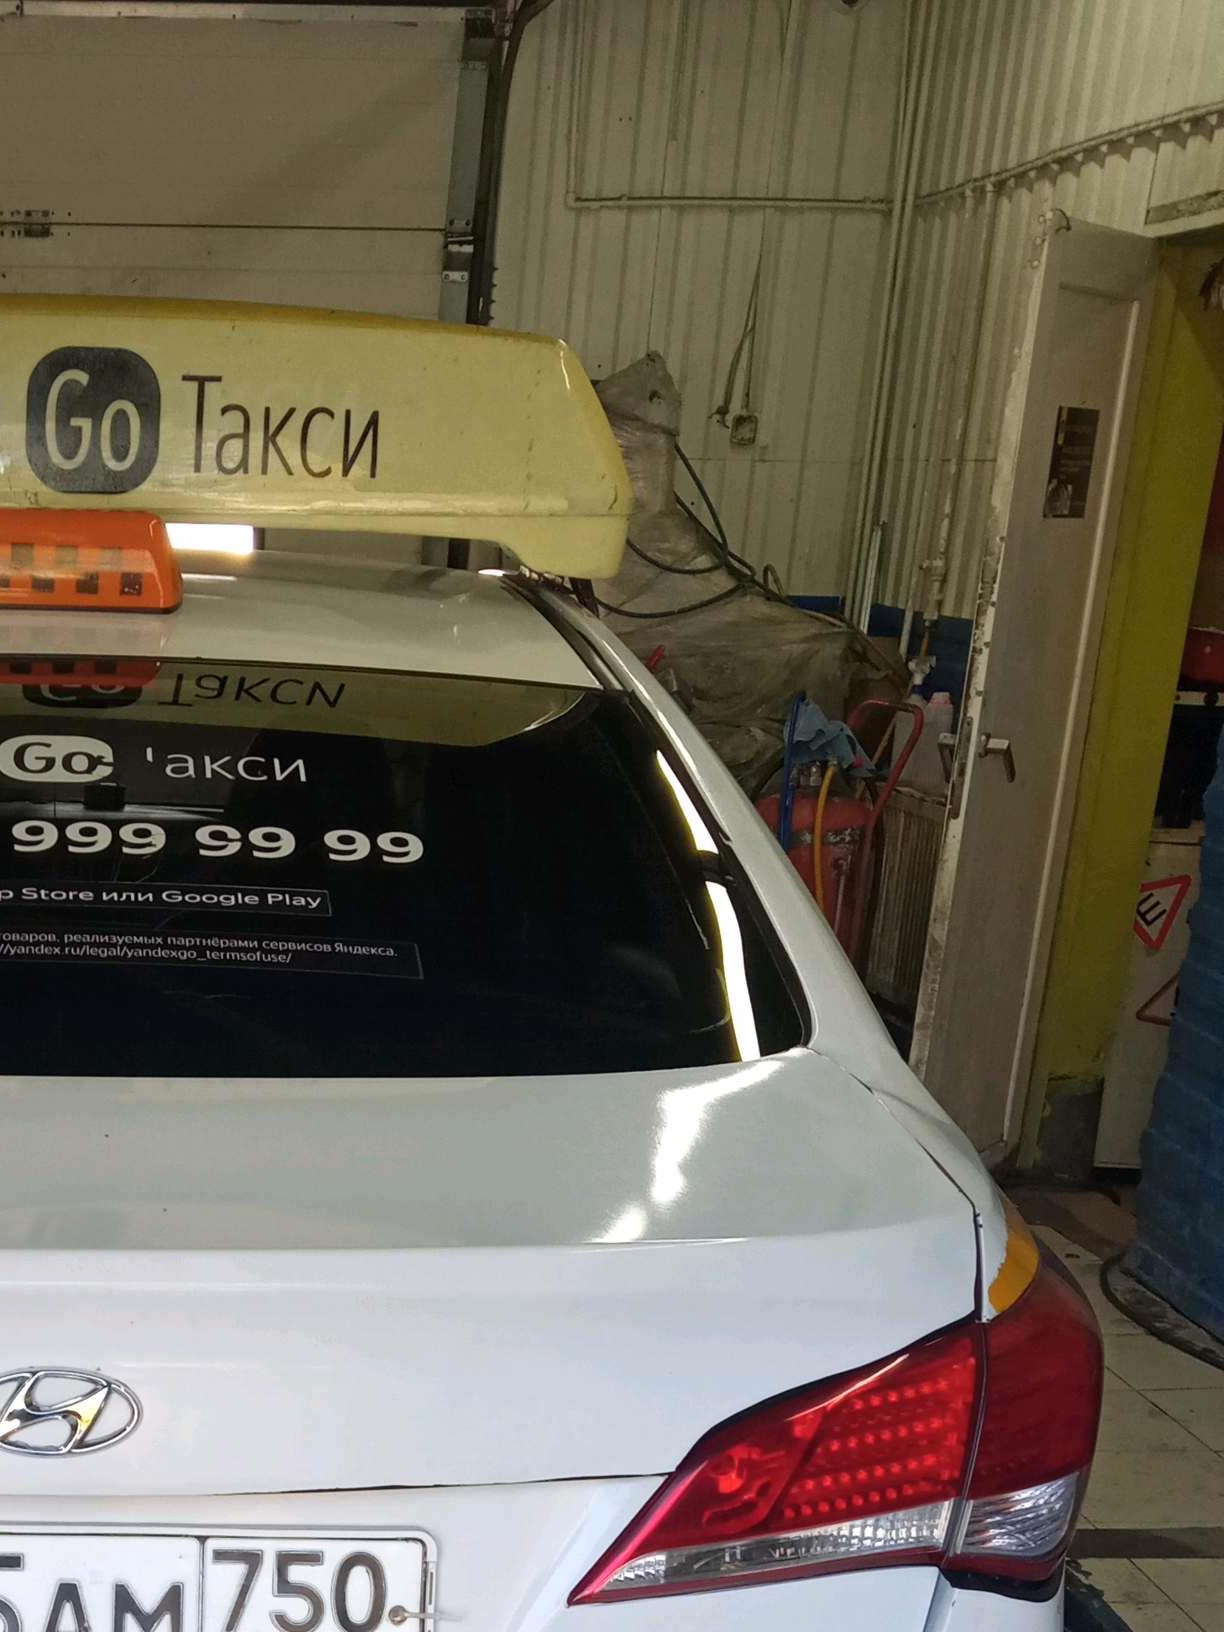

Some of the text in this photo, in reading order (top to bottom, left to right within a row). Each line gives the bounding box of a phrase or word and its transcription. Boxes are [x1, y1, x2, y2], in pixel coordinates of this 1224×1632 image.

[44, 368, 141, 472] Go
[181, 374, 380, 479] Такси
[13, 742, 106, 775] Go
[145, 746, 307, 782] акси
[11, 820, 167, 855] 999
[195, 825, 296, 859] 99
[323, 829, 424, 864] 99
[21, 887, 94, 901] Store
[102, 890, 154, 902] или
[161, 890, 259, 906] Google
[267, 892, 322, 908] Play
[64, 933, 164, 946] реализуемых
[167, 936, 258, 949] партнёрами
[262, 939, 332, 953] сервисов
[334, 942, 398, 957] Яндекса.
